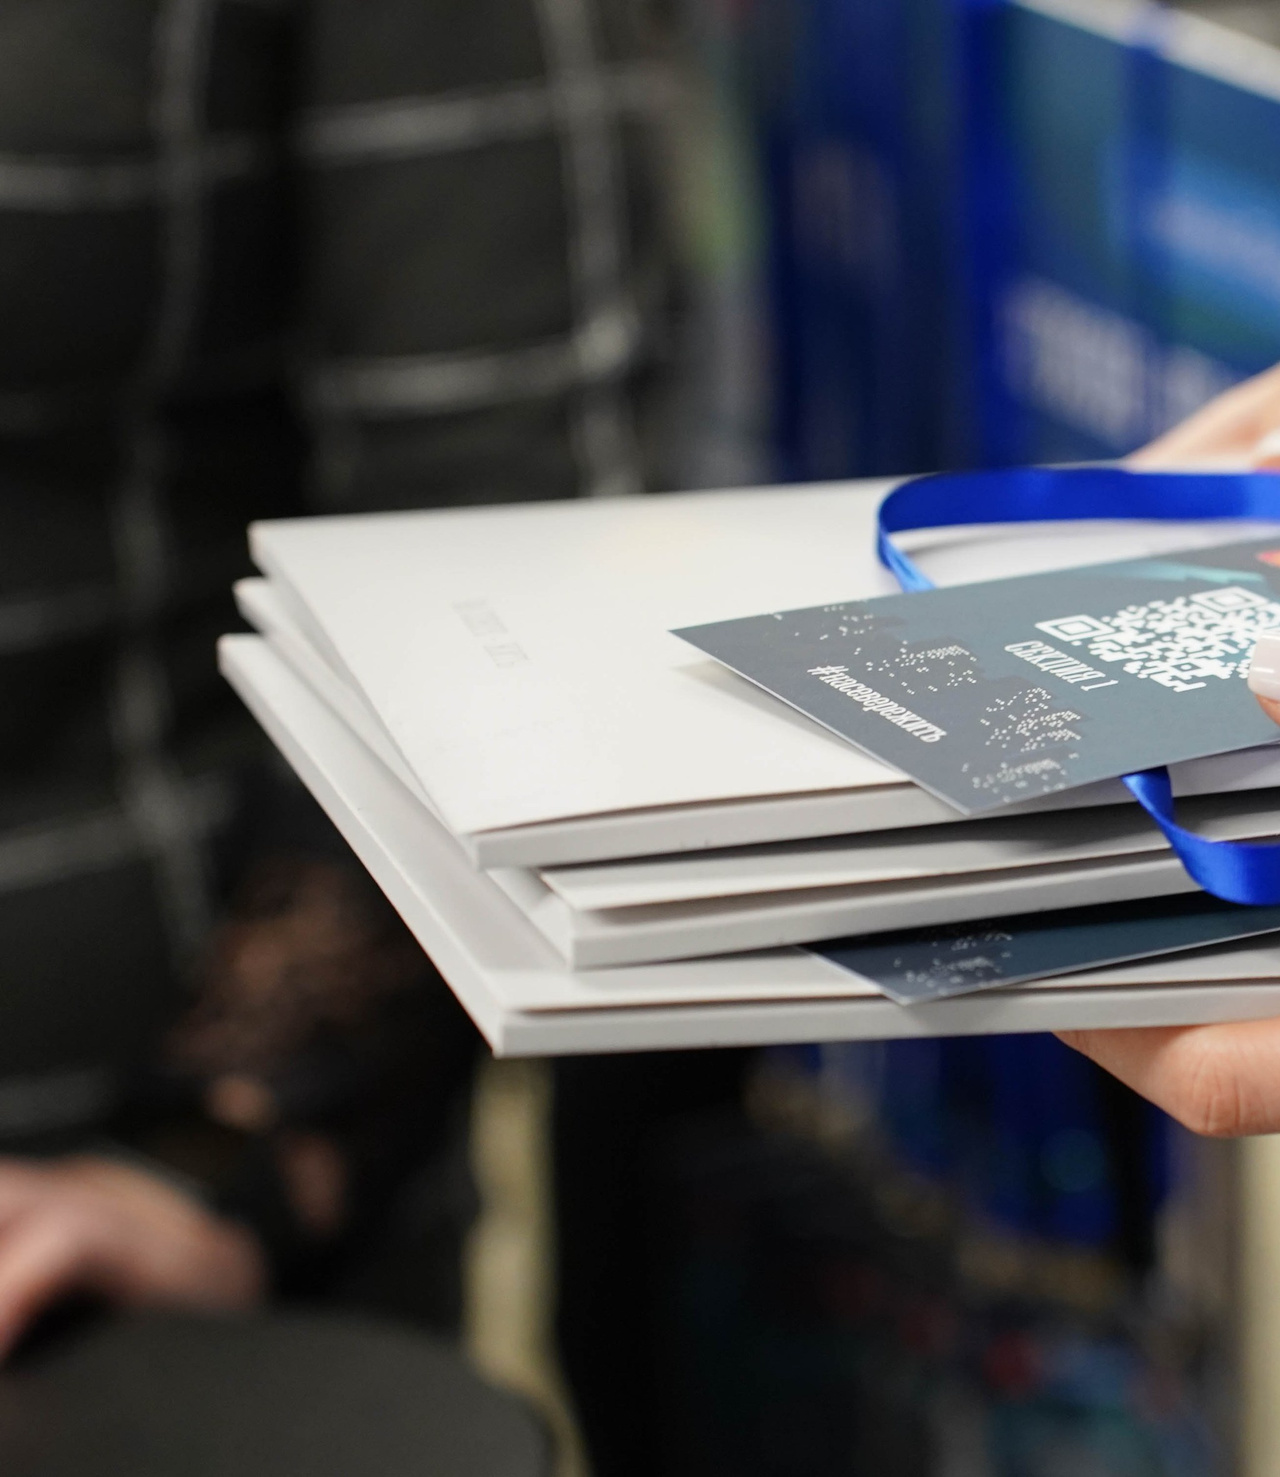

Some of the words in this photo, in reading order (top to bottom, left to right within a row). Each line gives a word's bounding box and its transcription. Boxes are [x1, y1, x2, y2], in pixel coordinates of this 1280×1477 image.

[1004, 640, 1106, 684] СЕКЦИЯ
[1081, 679, 1119, 691] 1
[807, 665, 947, 743] #насевережить
